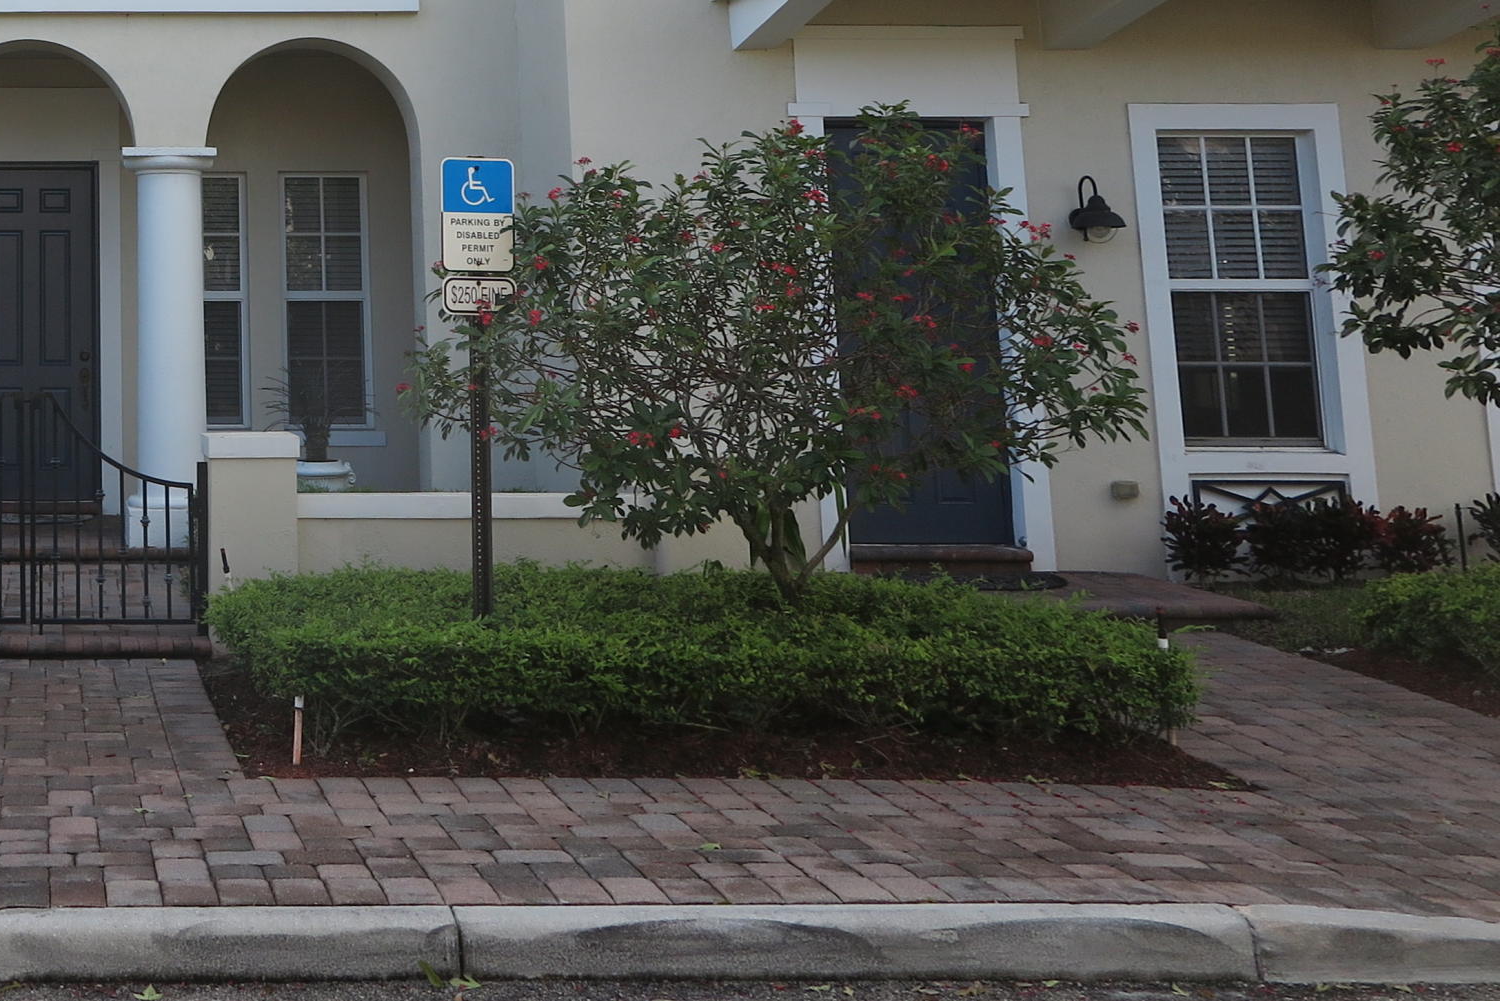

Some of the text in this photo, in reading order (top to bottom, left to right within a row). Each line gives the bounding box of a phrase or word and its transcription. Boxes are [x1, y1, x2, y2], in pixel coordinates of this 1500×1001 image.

[450, 218, 505, 227] PARKING BY
[456, 231, 500, 239] DISABLED
[461, 244, 495, 252] PERMIT
[466, 257, 491, 265] ONLY
[451, 285, 477, 304] $250
